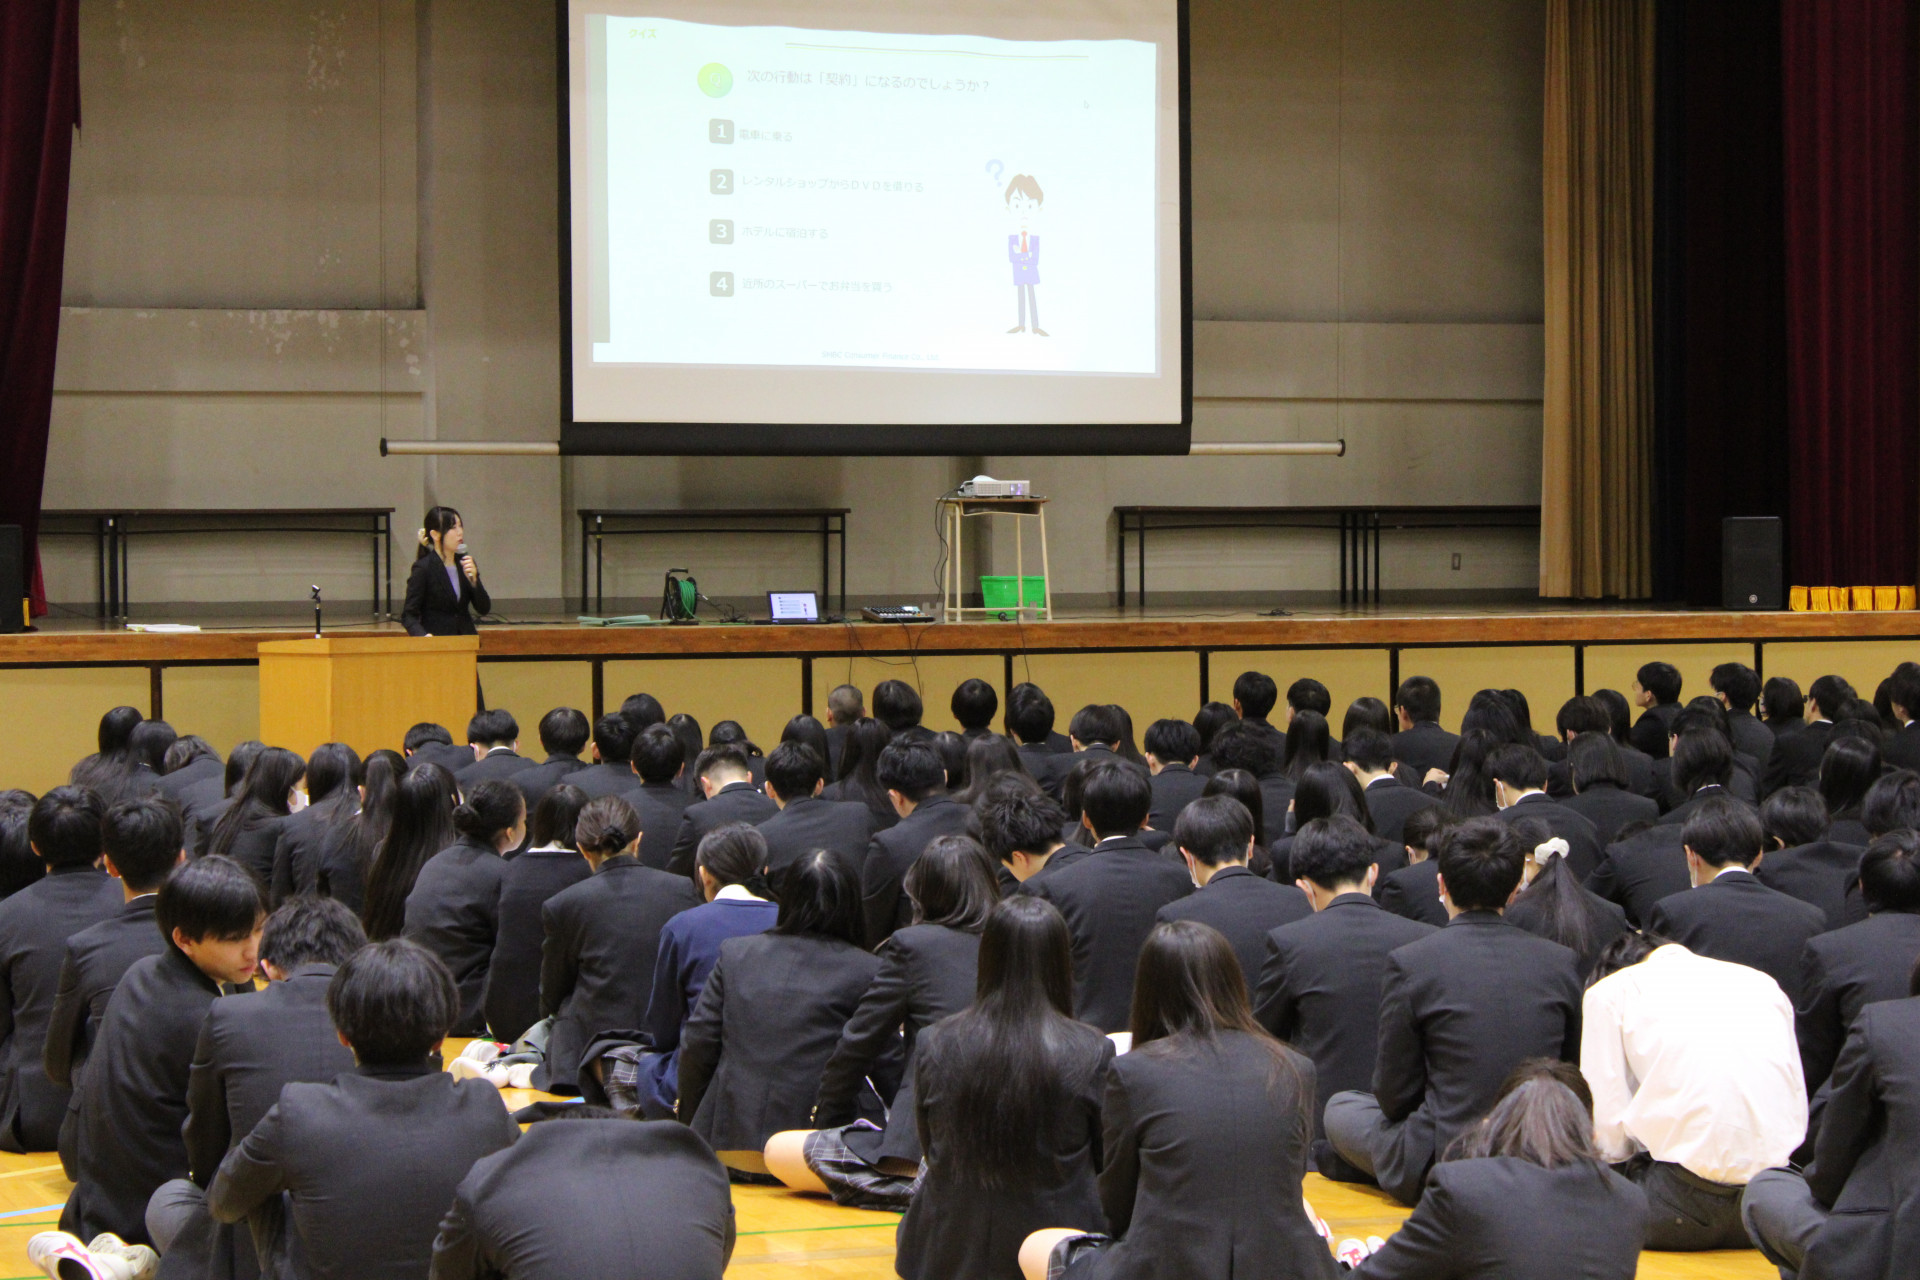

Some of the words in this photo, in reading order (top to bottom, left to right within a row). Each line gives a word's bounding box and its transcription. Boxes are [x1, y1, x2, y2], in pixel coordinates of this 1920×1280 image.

[628, 28, 657, 40] クイズ
[717, 123, 727, 138] 1
[716, 174, 727, 189] 2
[716, 224, 727, 239] 3
[716, 276, 728, 292] 4
